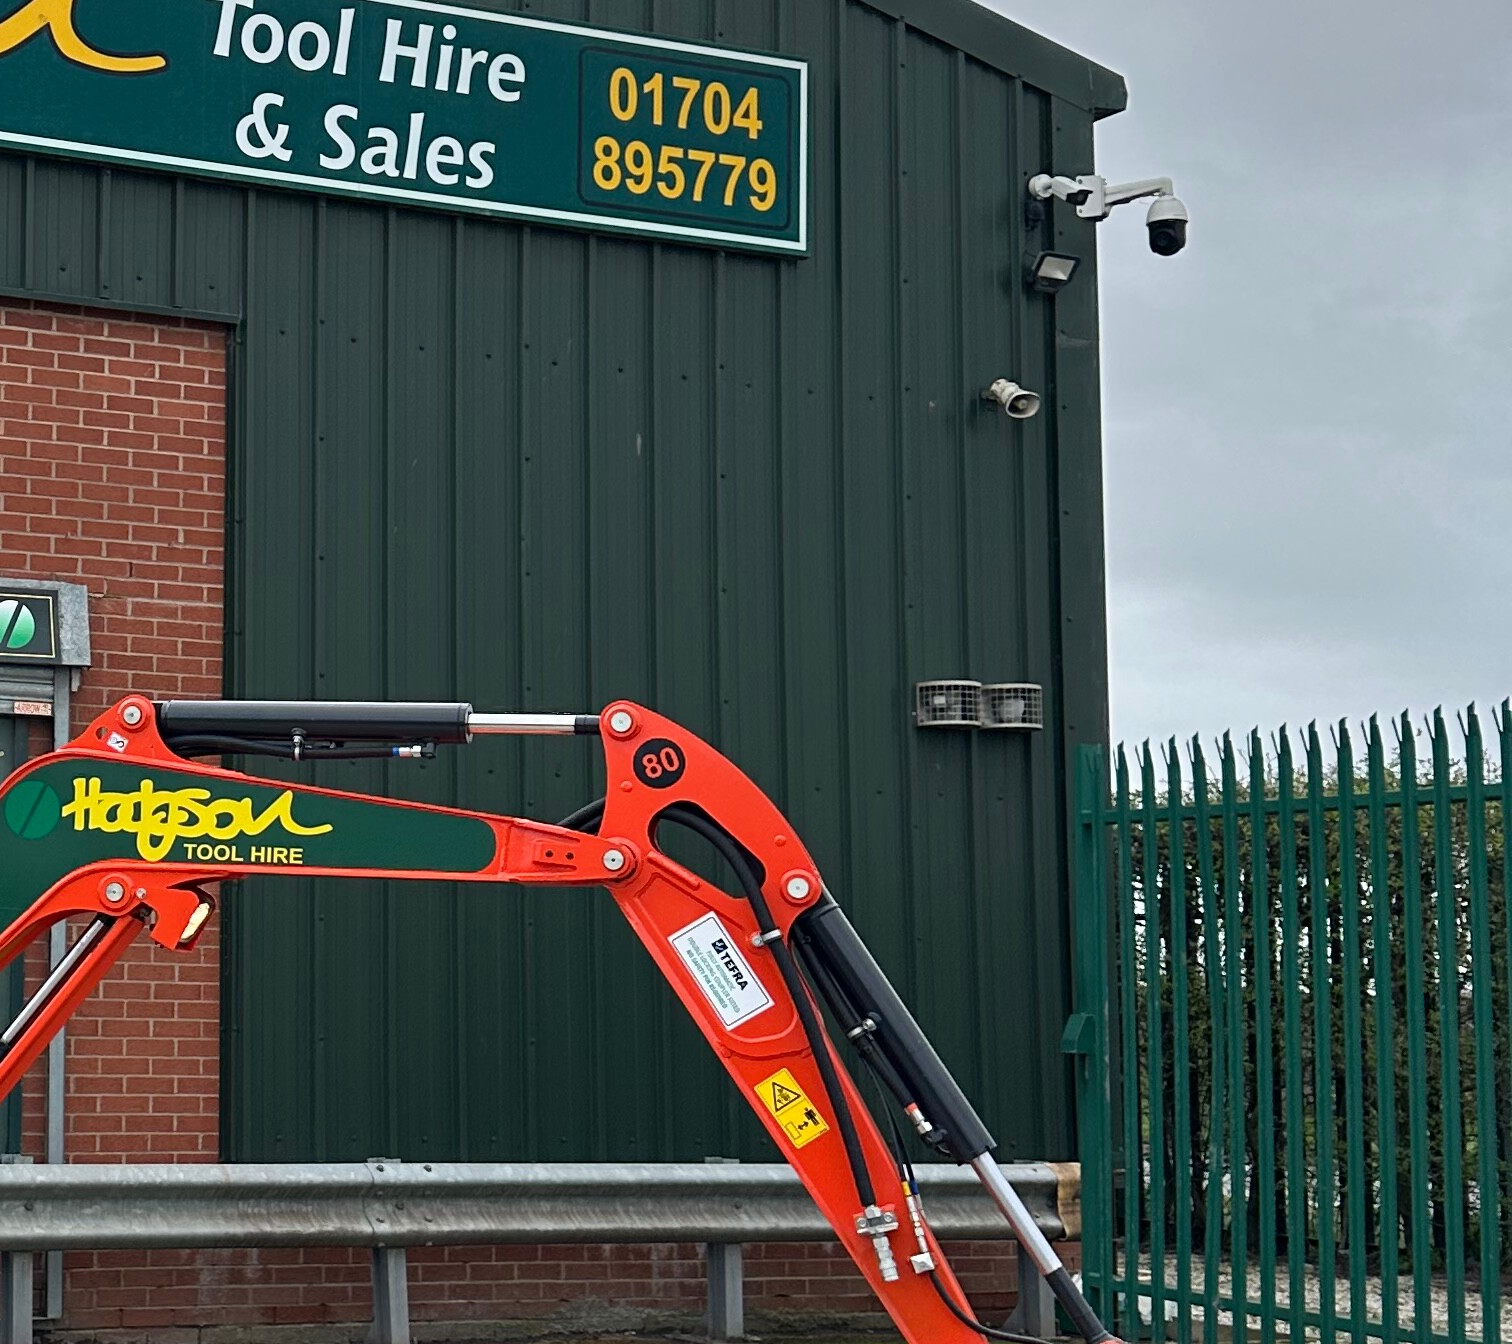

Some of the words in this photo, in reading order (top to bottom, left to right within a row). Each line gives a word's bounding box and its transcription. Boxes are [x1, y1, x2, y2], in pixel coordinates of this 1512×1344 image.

[379, 19, 526, 103] Hire
[608, 67, 763, 140] 01704
[235, 93, 292, 162] &
[319, 104, 496, 189] Sales
[593, 136, 777, 212] 895779
[642, 747, 679, 778] 80
[62, 777, 333, 862] Hodgson
[183, 843, 244, 862] TOOL
[250, 845, 303, 865] HIRE
[720, 952, 748, 991] TEFRA
